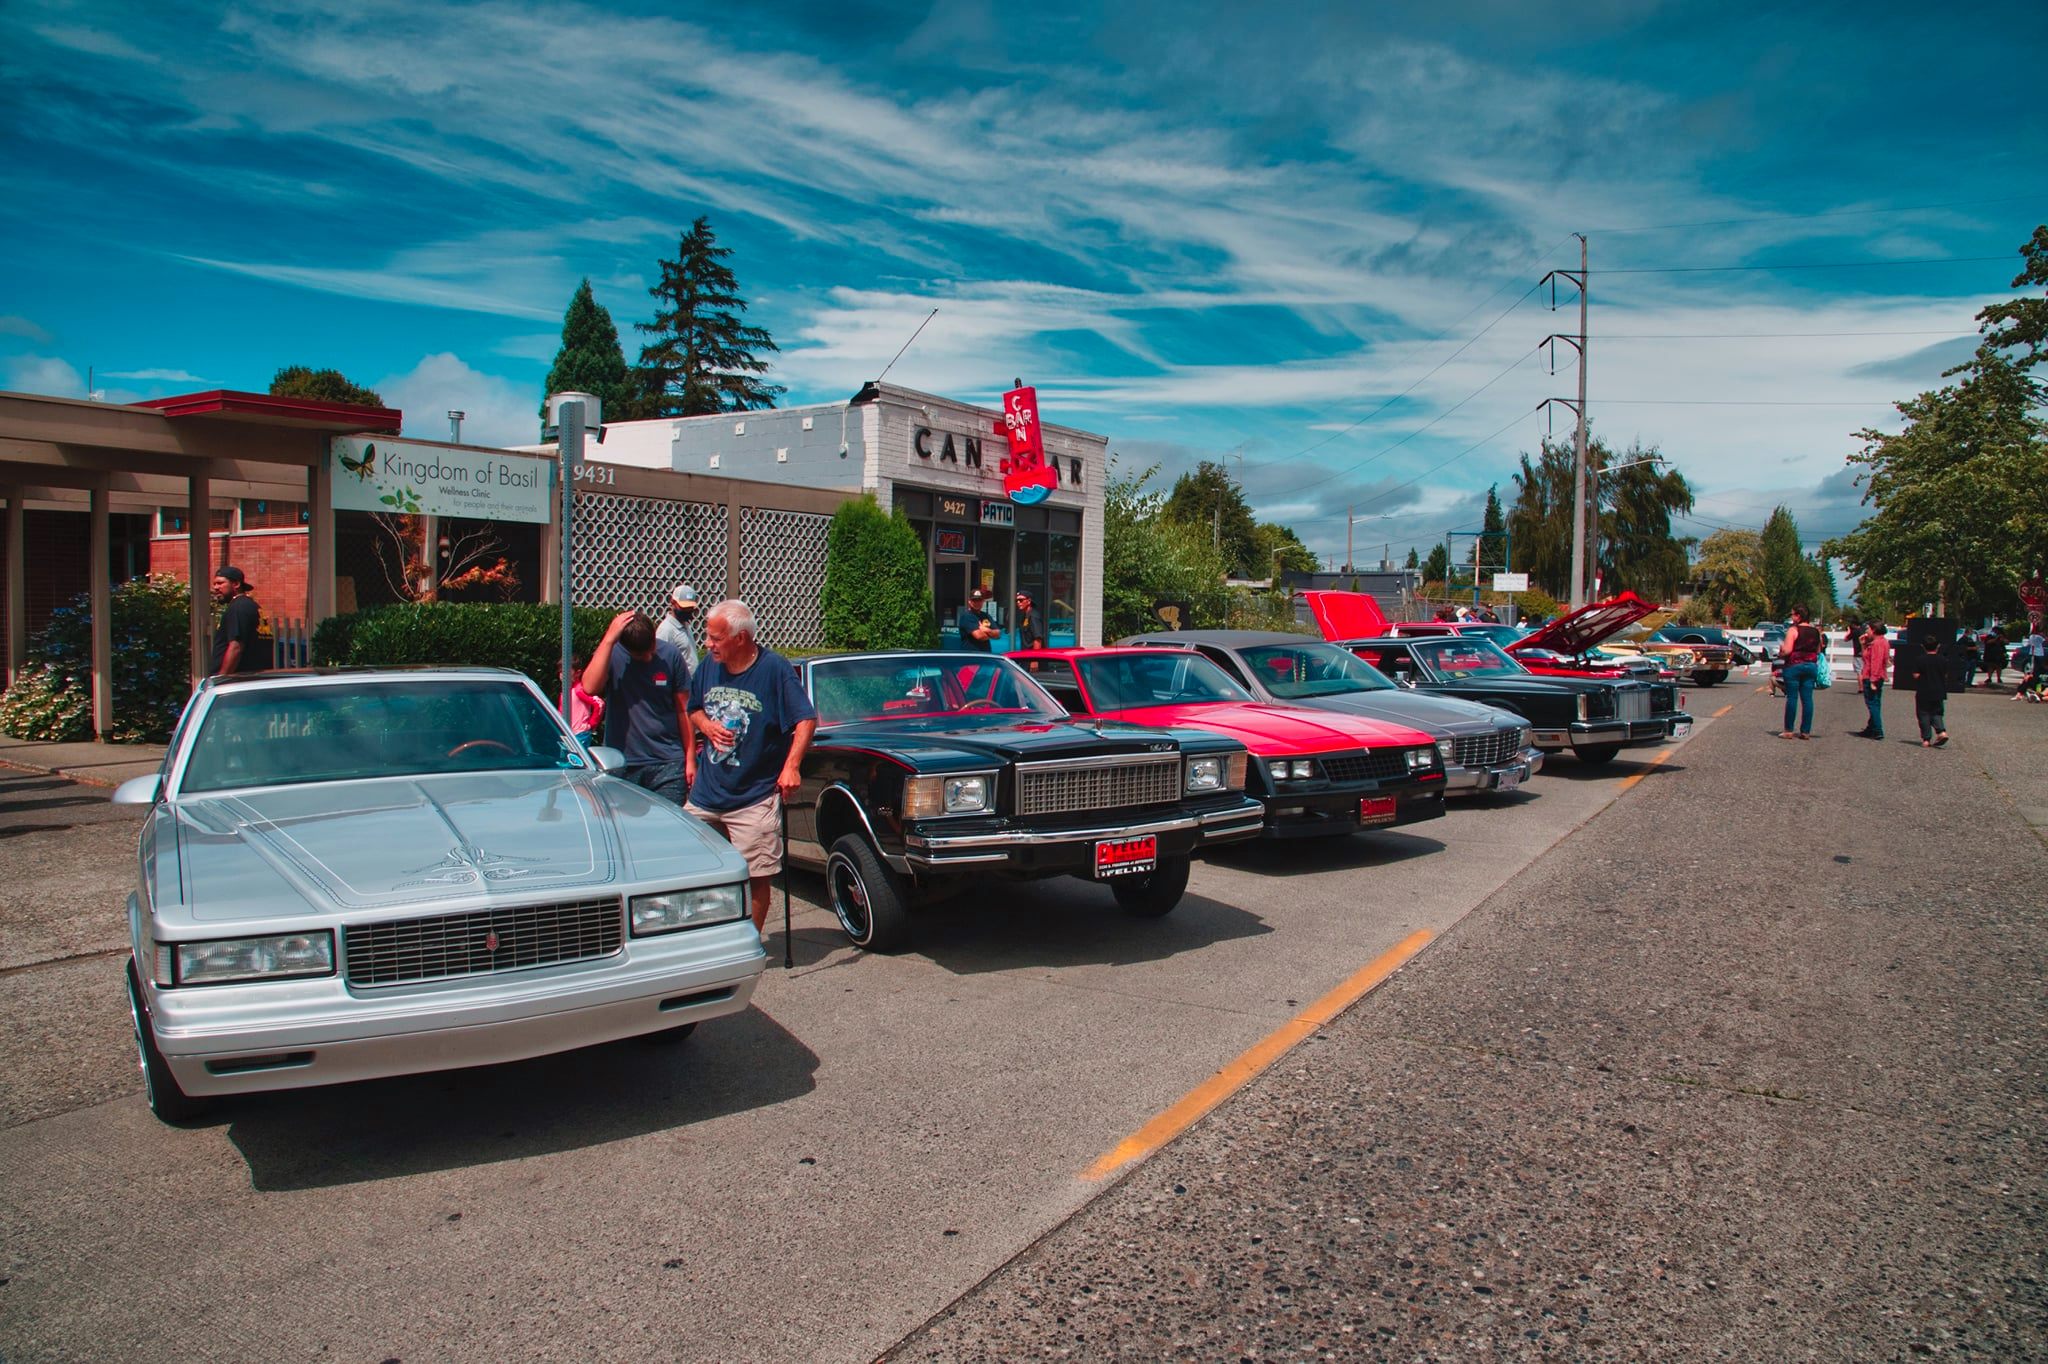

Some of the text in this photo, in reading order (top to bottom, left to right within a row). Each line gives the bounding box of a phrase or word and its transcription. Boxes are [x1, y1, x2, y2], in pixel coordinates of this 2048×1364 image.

[914, 427, 1082, 485] CAN AR
[383, 451, 538, 489] Kingdom of Basil
[573, 464, 616, 486] 9431
[438, 485, 491, 499] Wellness Clinic
[453, 498, 537, 513] for people and their animals
[943, 500, 966, 516] 9427
[982, 503, 1013, 522] PATIO
[1106, 865, 1146, 877] FELIX
